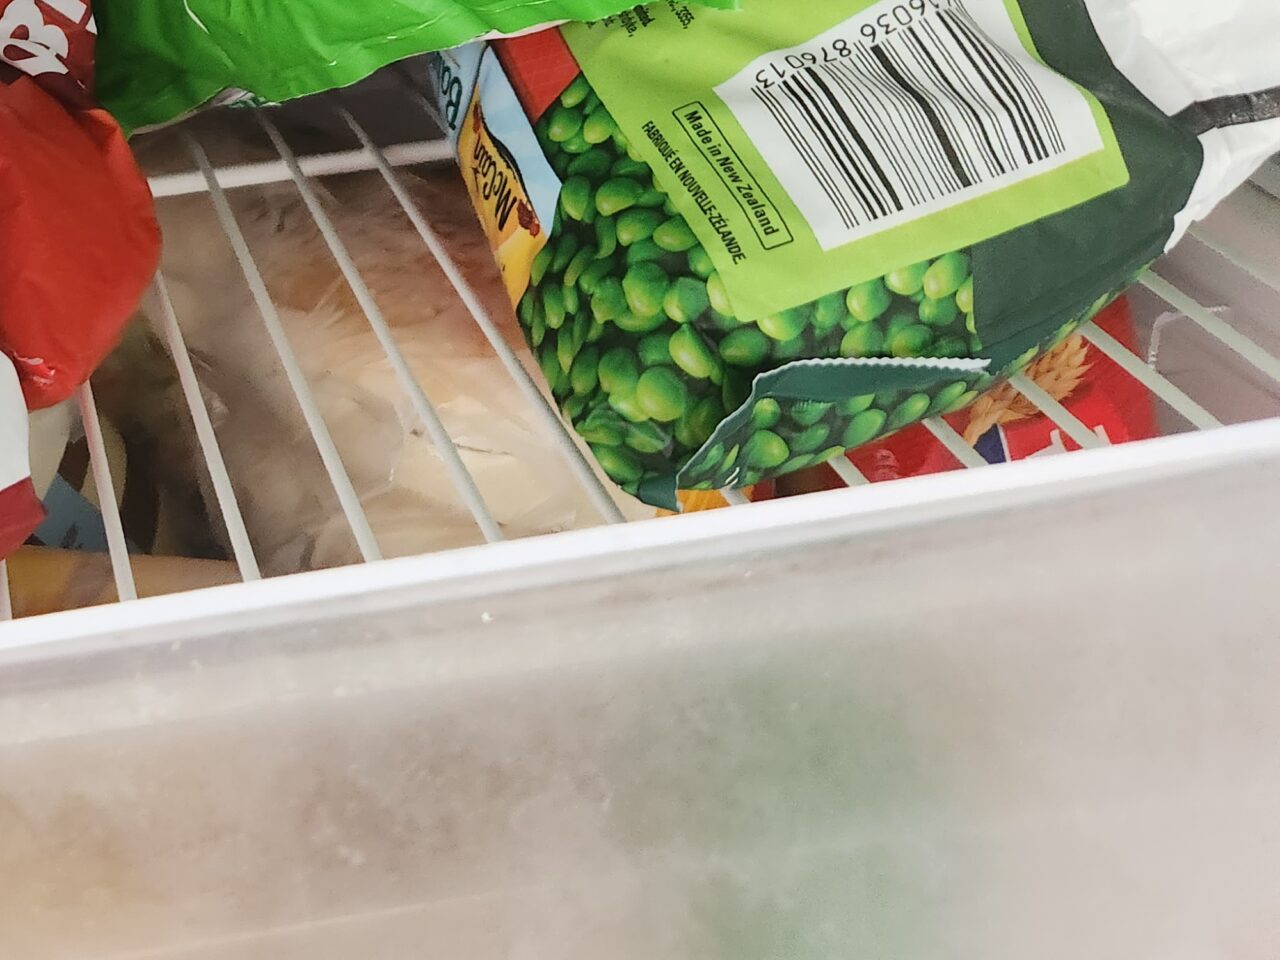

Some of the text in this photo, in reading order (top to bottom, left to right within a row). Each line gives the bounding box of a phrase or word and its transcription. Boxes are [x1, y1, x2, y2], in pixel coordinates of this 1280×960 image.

[755, 39, 852, 90] 876013
[474, 135, 517, 232] McCain
[641, 120, 679, 163] FABRIQUÉ
[670, 156, 686, 174] EN
[684, 110, 780, 236] Made in New Zealand
